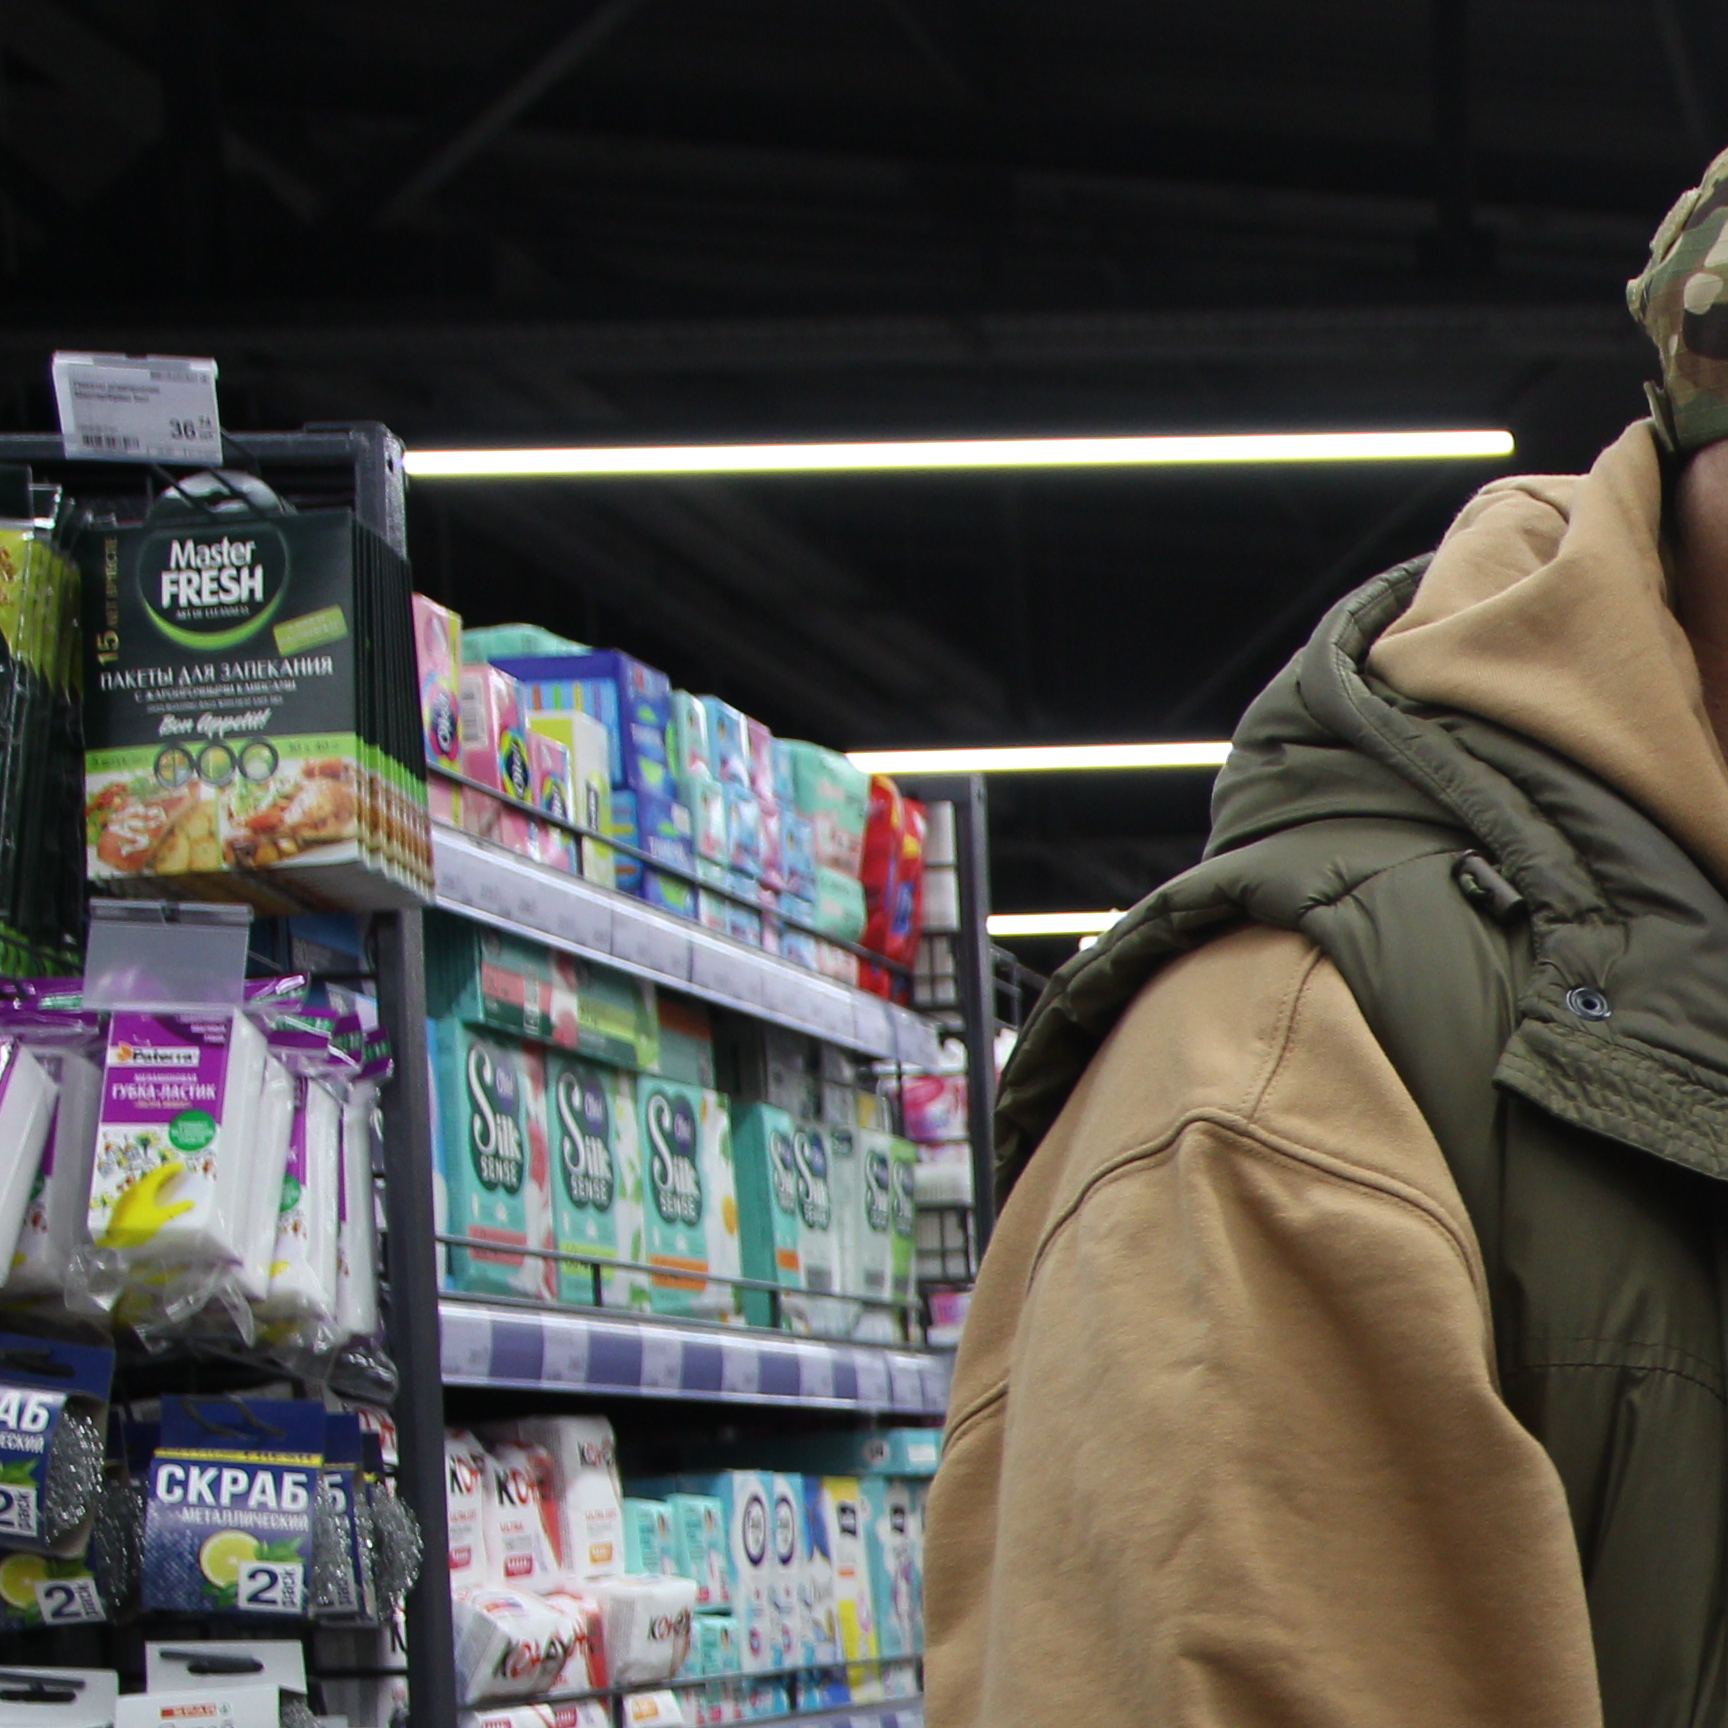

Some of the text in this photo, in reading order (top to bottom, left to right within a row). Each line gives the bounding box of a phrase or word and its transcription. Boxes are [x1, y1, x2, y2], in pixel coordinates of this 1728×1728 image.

[169, 417, 197, 441] 36
[170, 536, 257, 571] Master
[161, 564, 264, 610] FRESH
[96, 630, 121, 667] 15
[100, 655, 334, 691] ПАКЕТЫ ДЛЯ ЗАПЕКАНИЯ
[111, 1082, 218, 1101] ГУБКА-ЛАСТИК
[467, 1046, 523, 1164] Silk
[557, 1071, 613, 1182] Silk
[647, 1093, 701, 1196] Silk
[480, 1156, 518, 1185] SENSE
[570, 1174, 609, 1202] SENSE
[659, 1191, 698, 1217] SENSE
[156, 1462, 311, 1514] СКРАБ
[179, 1506, 311, 1533] МЕТАЛЛИЧЕСКИЙ
[43, 1584, 82, 1622] 2
[245, 1566, 281, 1606] 2
